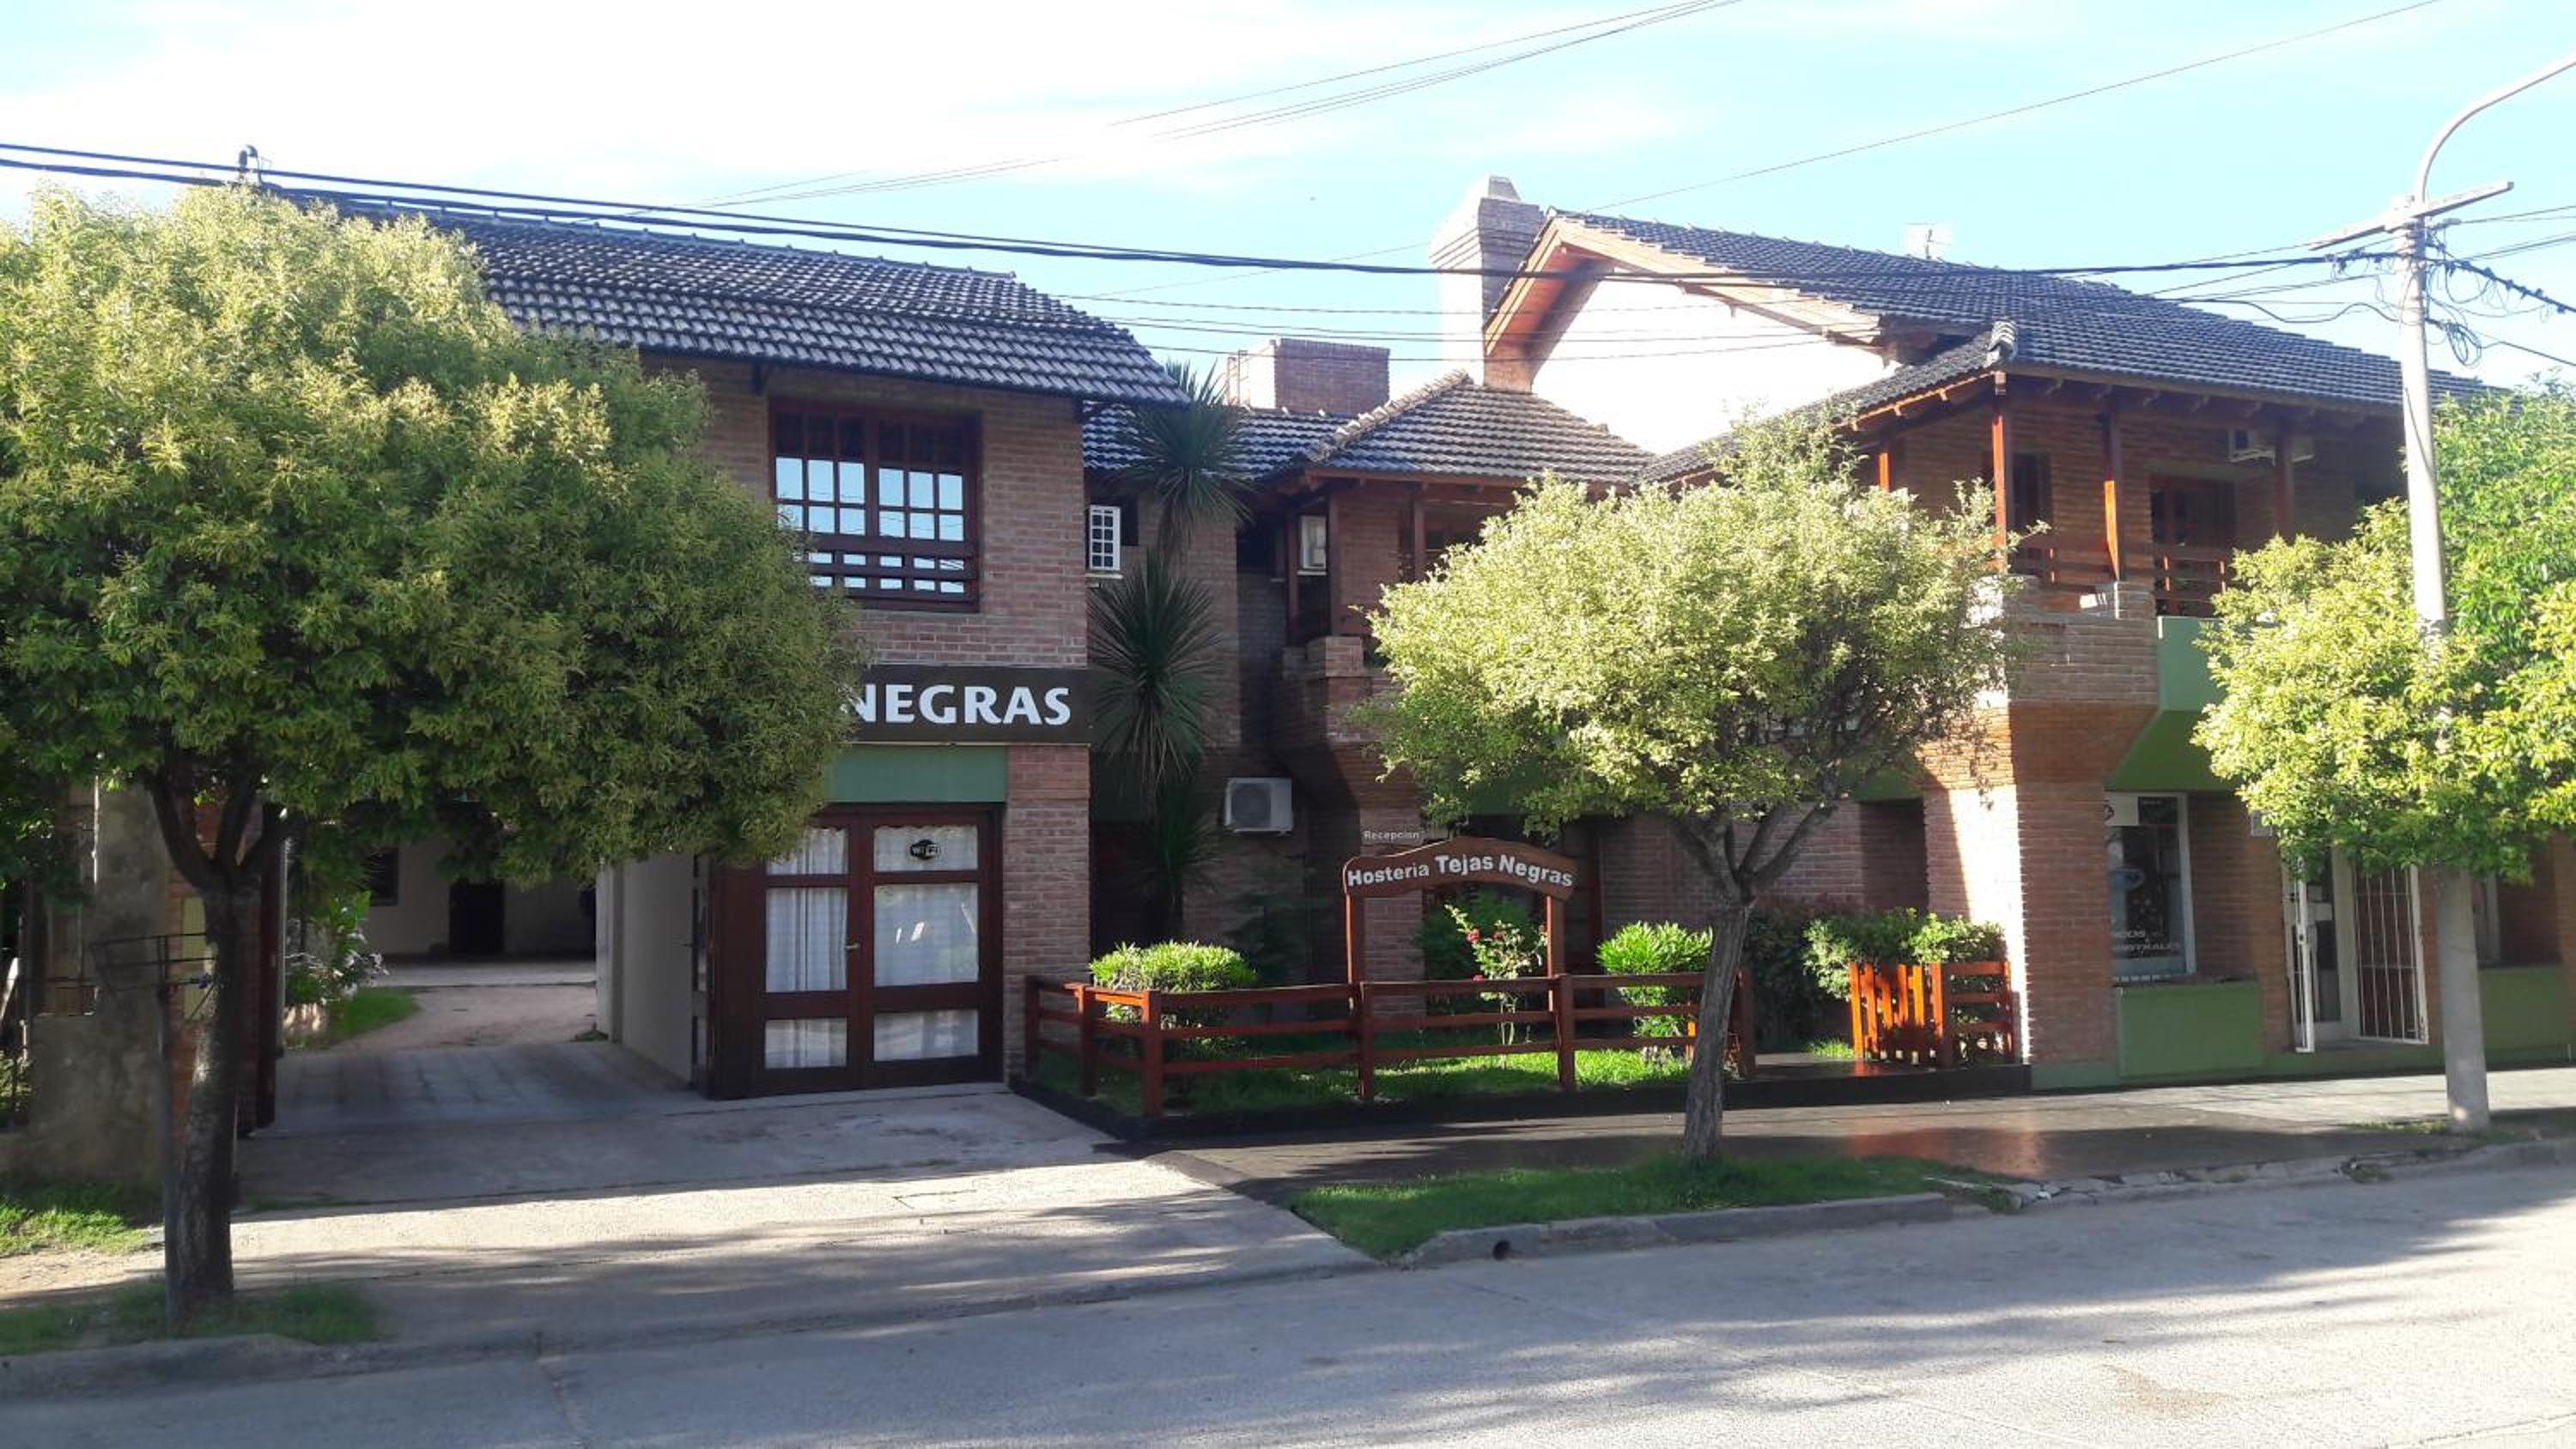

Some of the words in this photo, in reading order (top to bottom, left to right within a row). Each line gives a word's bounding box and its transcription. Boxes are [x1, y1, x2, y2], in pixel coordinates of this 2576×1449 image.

[1347, 862, 1430, 887] Hosteria
[1435, 854, 1494, 876] Tejas
[1498, 854, 1573, 887] Negras
